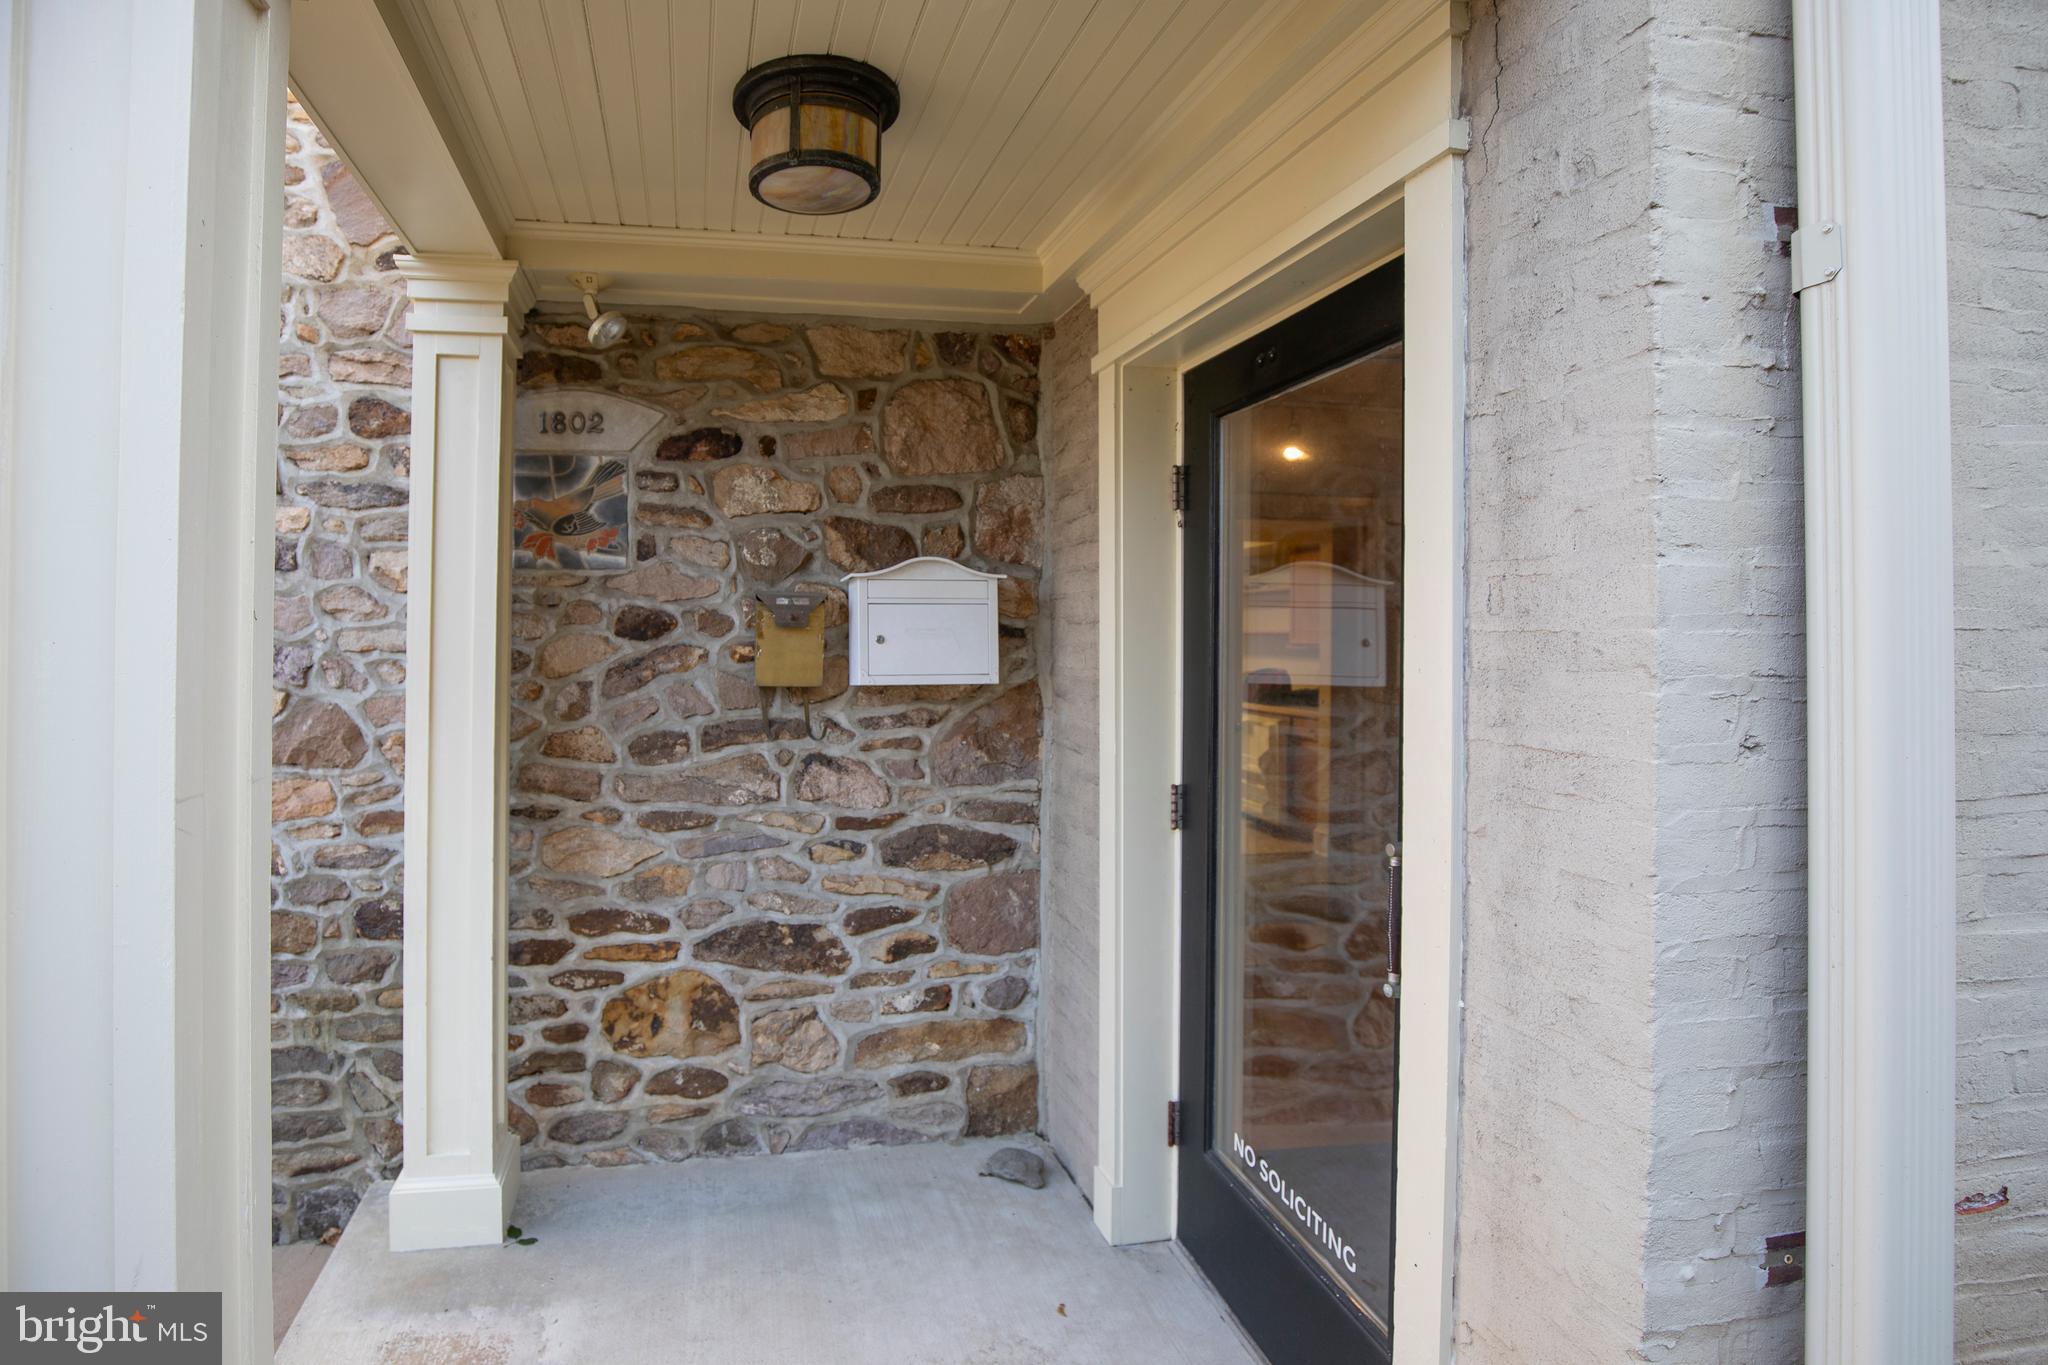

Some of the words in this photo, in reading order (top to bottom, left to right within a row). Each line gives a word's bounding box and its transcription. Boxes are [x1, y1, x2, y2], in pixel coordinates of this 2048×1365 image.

[539, 411, 605, 434] 1802
[1234, 1133, 1256, 1168] NO
[1259, 1159, 1357, 1273] SOLICITING
